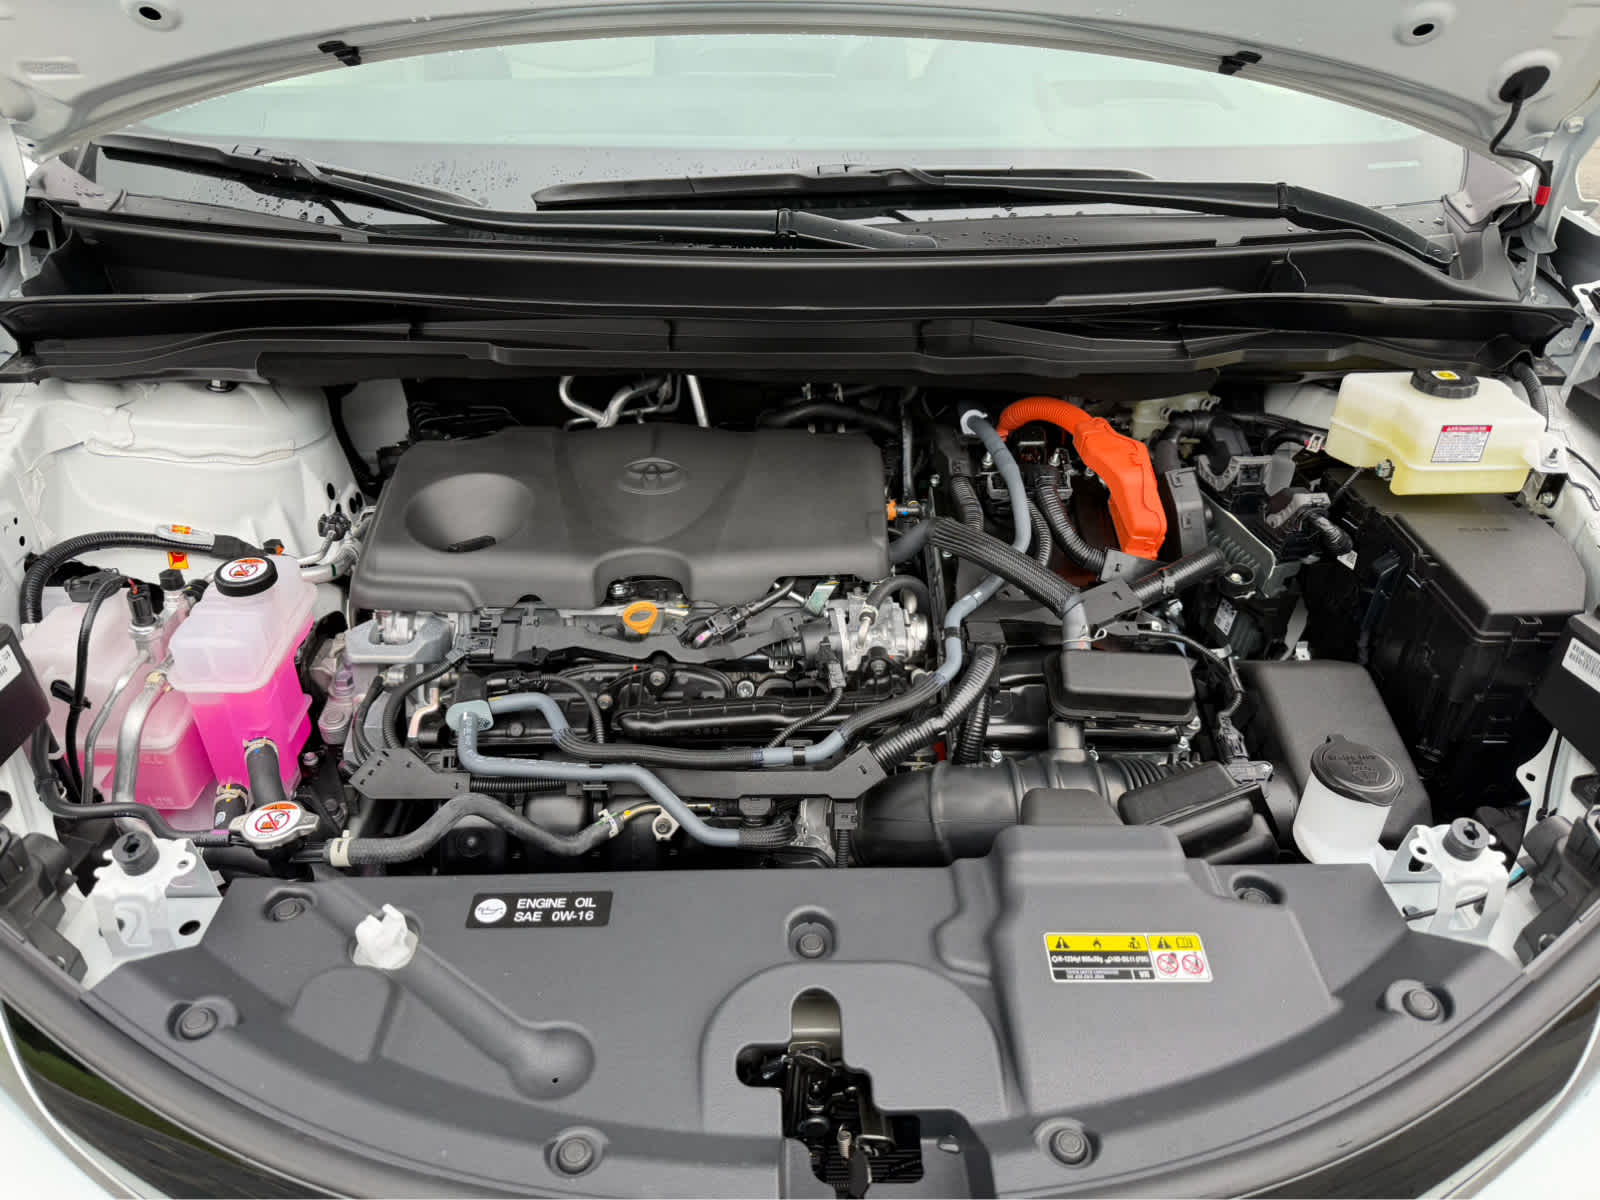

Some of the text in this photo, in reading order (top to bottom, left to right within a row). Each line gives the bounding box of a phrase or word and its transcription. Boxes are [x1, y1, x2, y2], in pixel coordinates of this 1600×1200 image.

[516, 897, 597, 909] ENGINE OIL
[513, 910, 594, 922] SAE 0W-16
